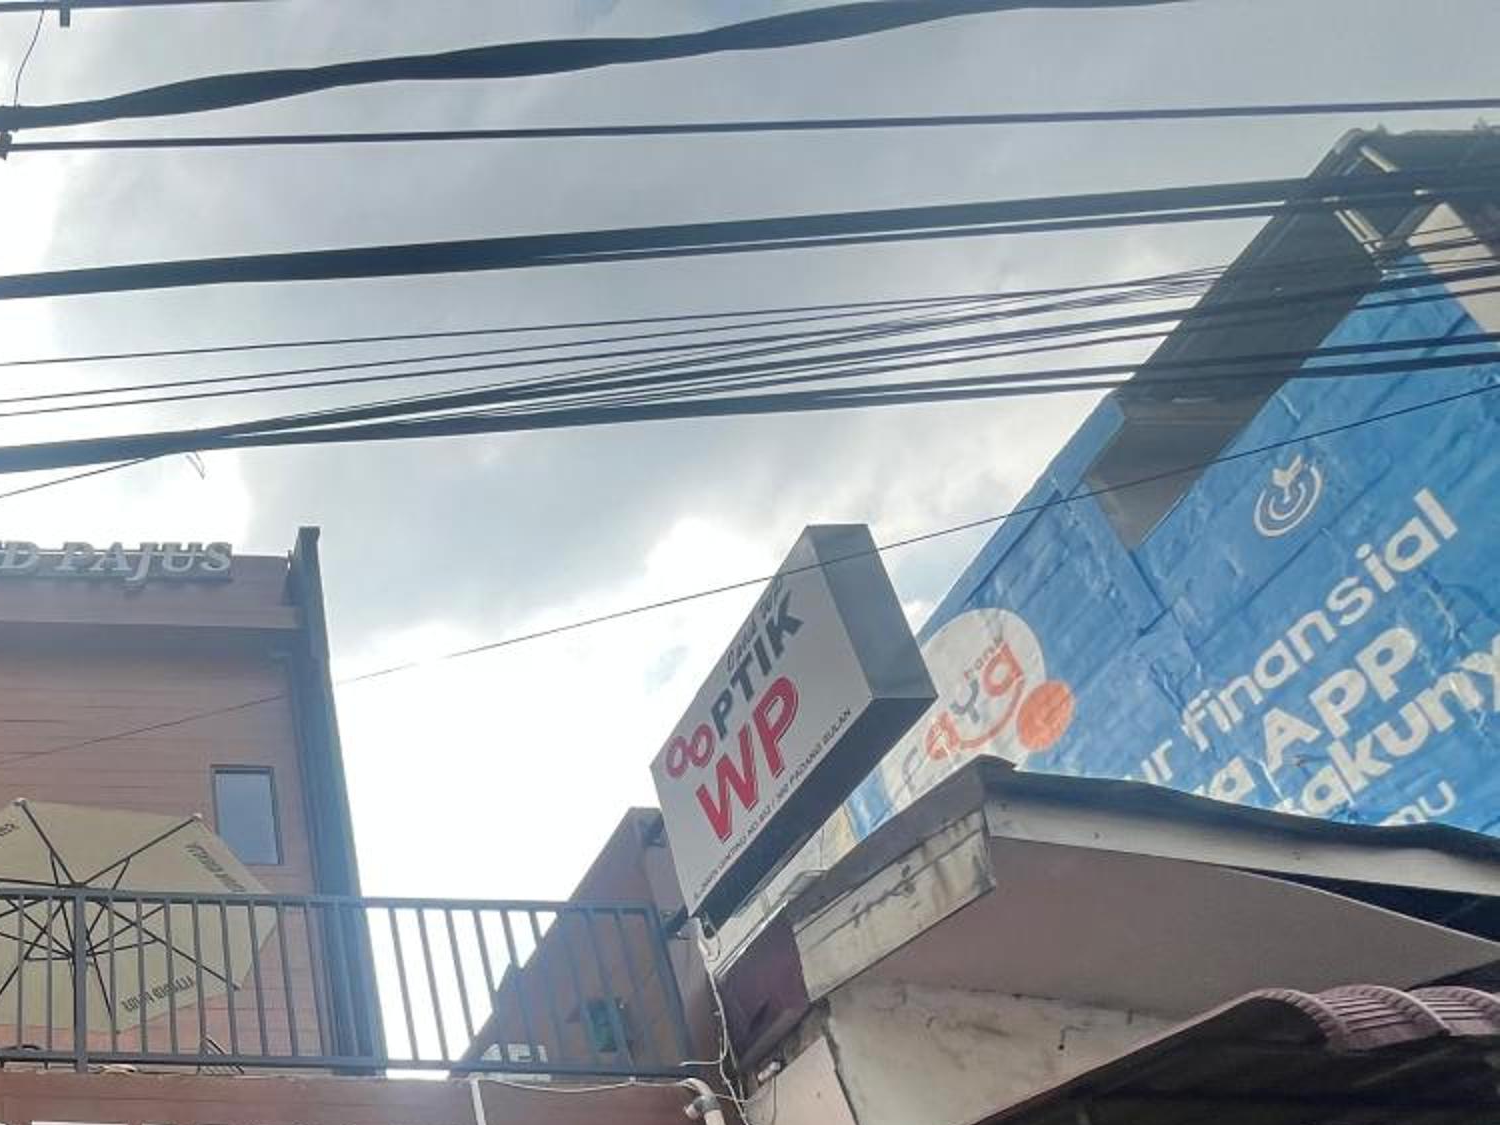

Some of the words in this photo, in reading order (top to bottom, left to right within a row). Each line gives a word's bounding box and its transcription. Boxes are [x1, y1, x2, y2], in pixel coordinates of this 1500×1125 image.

[56, 541, 232, 582] PAJUS
[1182, 487, 1458, 751] finansial
[695, 676, 800, 843] WP
